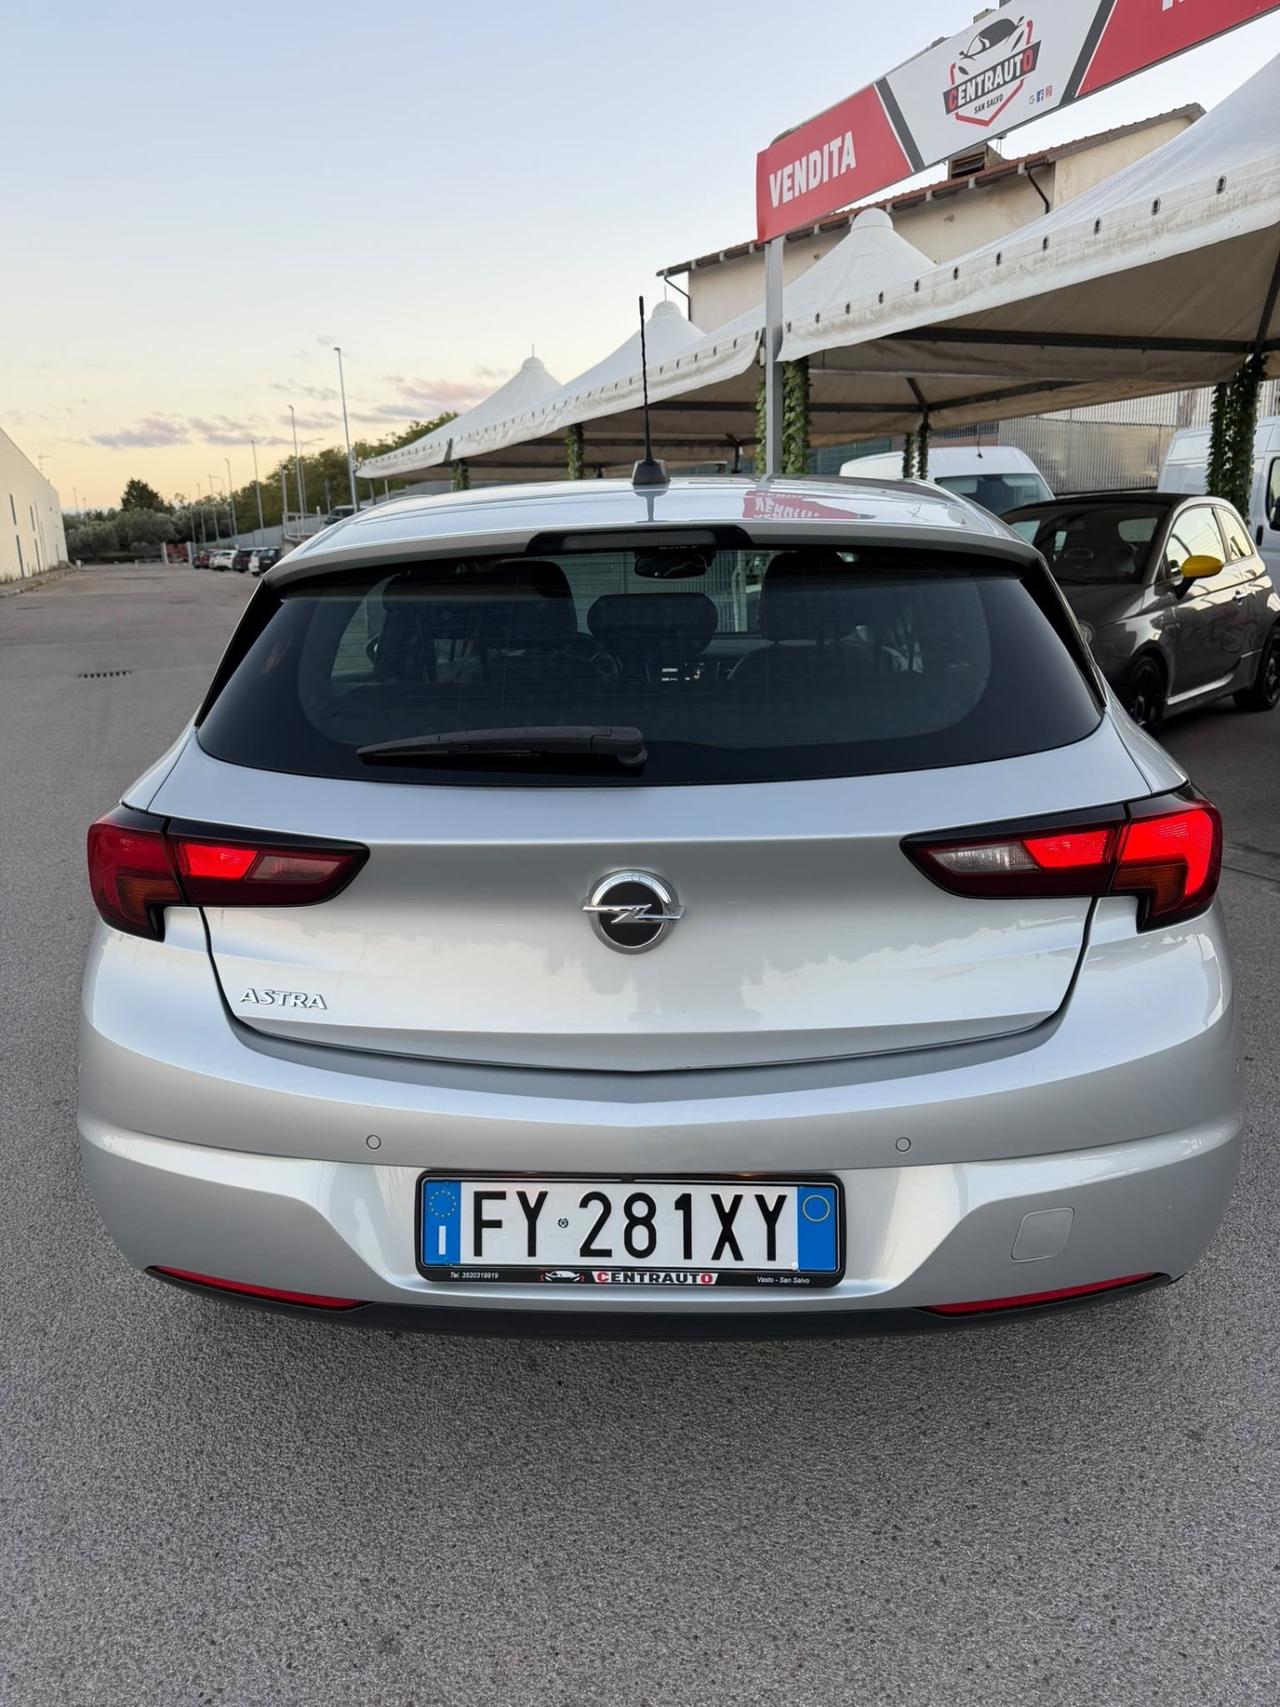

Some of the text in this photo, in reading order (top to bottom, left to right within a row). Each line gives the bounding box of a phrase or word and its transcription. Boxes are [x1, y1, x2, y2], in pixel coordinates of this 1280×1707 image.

[947, 48, 1034, 112] CENTRAUTO
[974, 93, 1003, 115] SAN SALVO
[769, 130, 856, 208] VENDITA
[239, 988, 327, 1010] ASTRA
[597, 1271, 713, 1284] CENTRAUTO
[757, 1276, 775, 1284] Vasto
[779, 1276, 792, 1284] San
